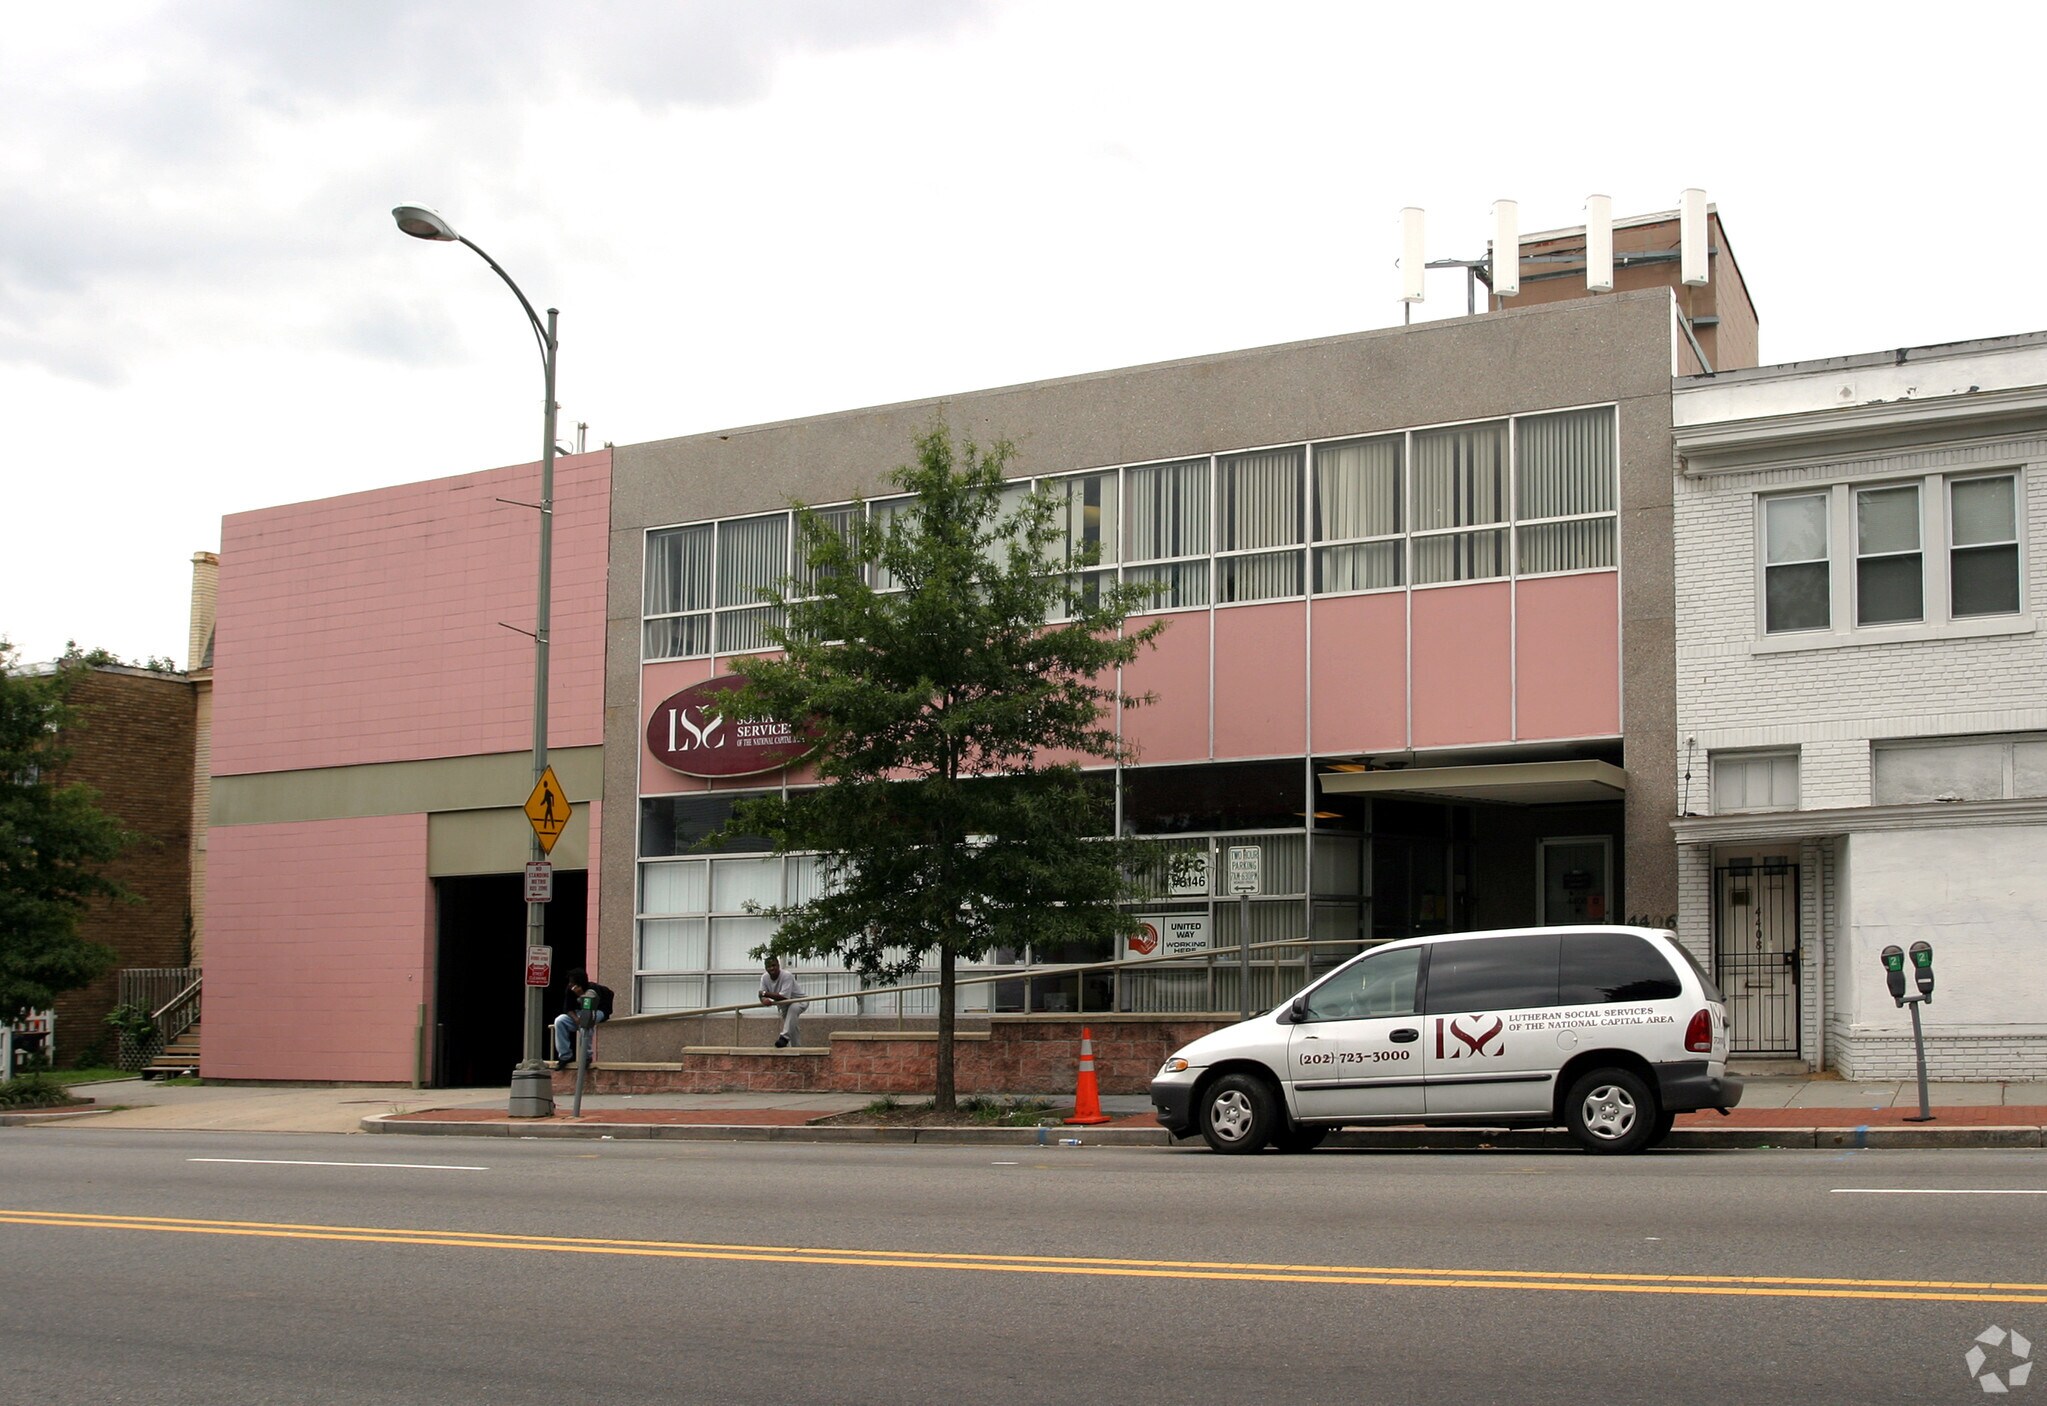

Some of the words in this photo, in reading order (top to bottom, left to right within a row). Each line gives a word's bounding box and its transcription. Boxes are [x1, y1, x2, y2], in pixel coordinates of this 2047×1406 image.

[736, 739, 742, 747] OF
[744, 738, 752, 746] THE
[753, 737, 774, 746] NATIONAL
[774, 735, 792, 745] CAPITAL
[1231, 850, 1242, 860] TWO
[1243, 850, 1259, 860] HOUR
[1231, 861, 1257, 870] PARKING
[1627, 912, 1678, 929] 4406
[1171, 922, 1202, 931] UNITED
[1176, 931, 1195, 939] WAY
[1890, 956, 1898, 966] 2
[1919, 952, 1926, 962] 2
[1509, 1012, 1562, 1022] LUTHERAN
[1564, 1010, 1600, 1019] SOCIAL
[1604, 1007, 1654, 1017] SERVICES
[1509, 1023, 1522, 1031] OF
[1525, 1022, 1545, 1030] THE
[1548, 1019, 1598, 1029] NATIONAL
[1600, 1017, 1644, 1027] CAPITAL
[1646, 1015, 1675, 1025] AREA
[1299, 1051, 1335, 1065] (202)
[1339, 1050, 1410, 1063] 723-3000
